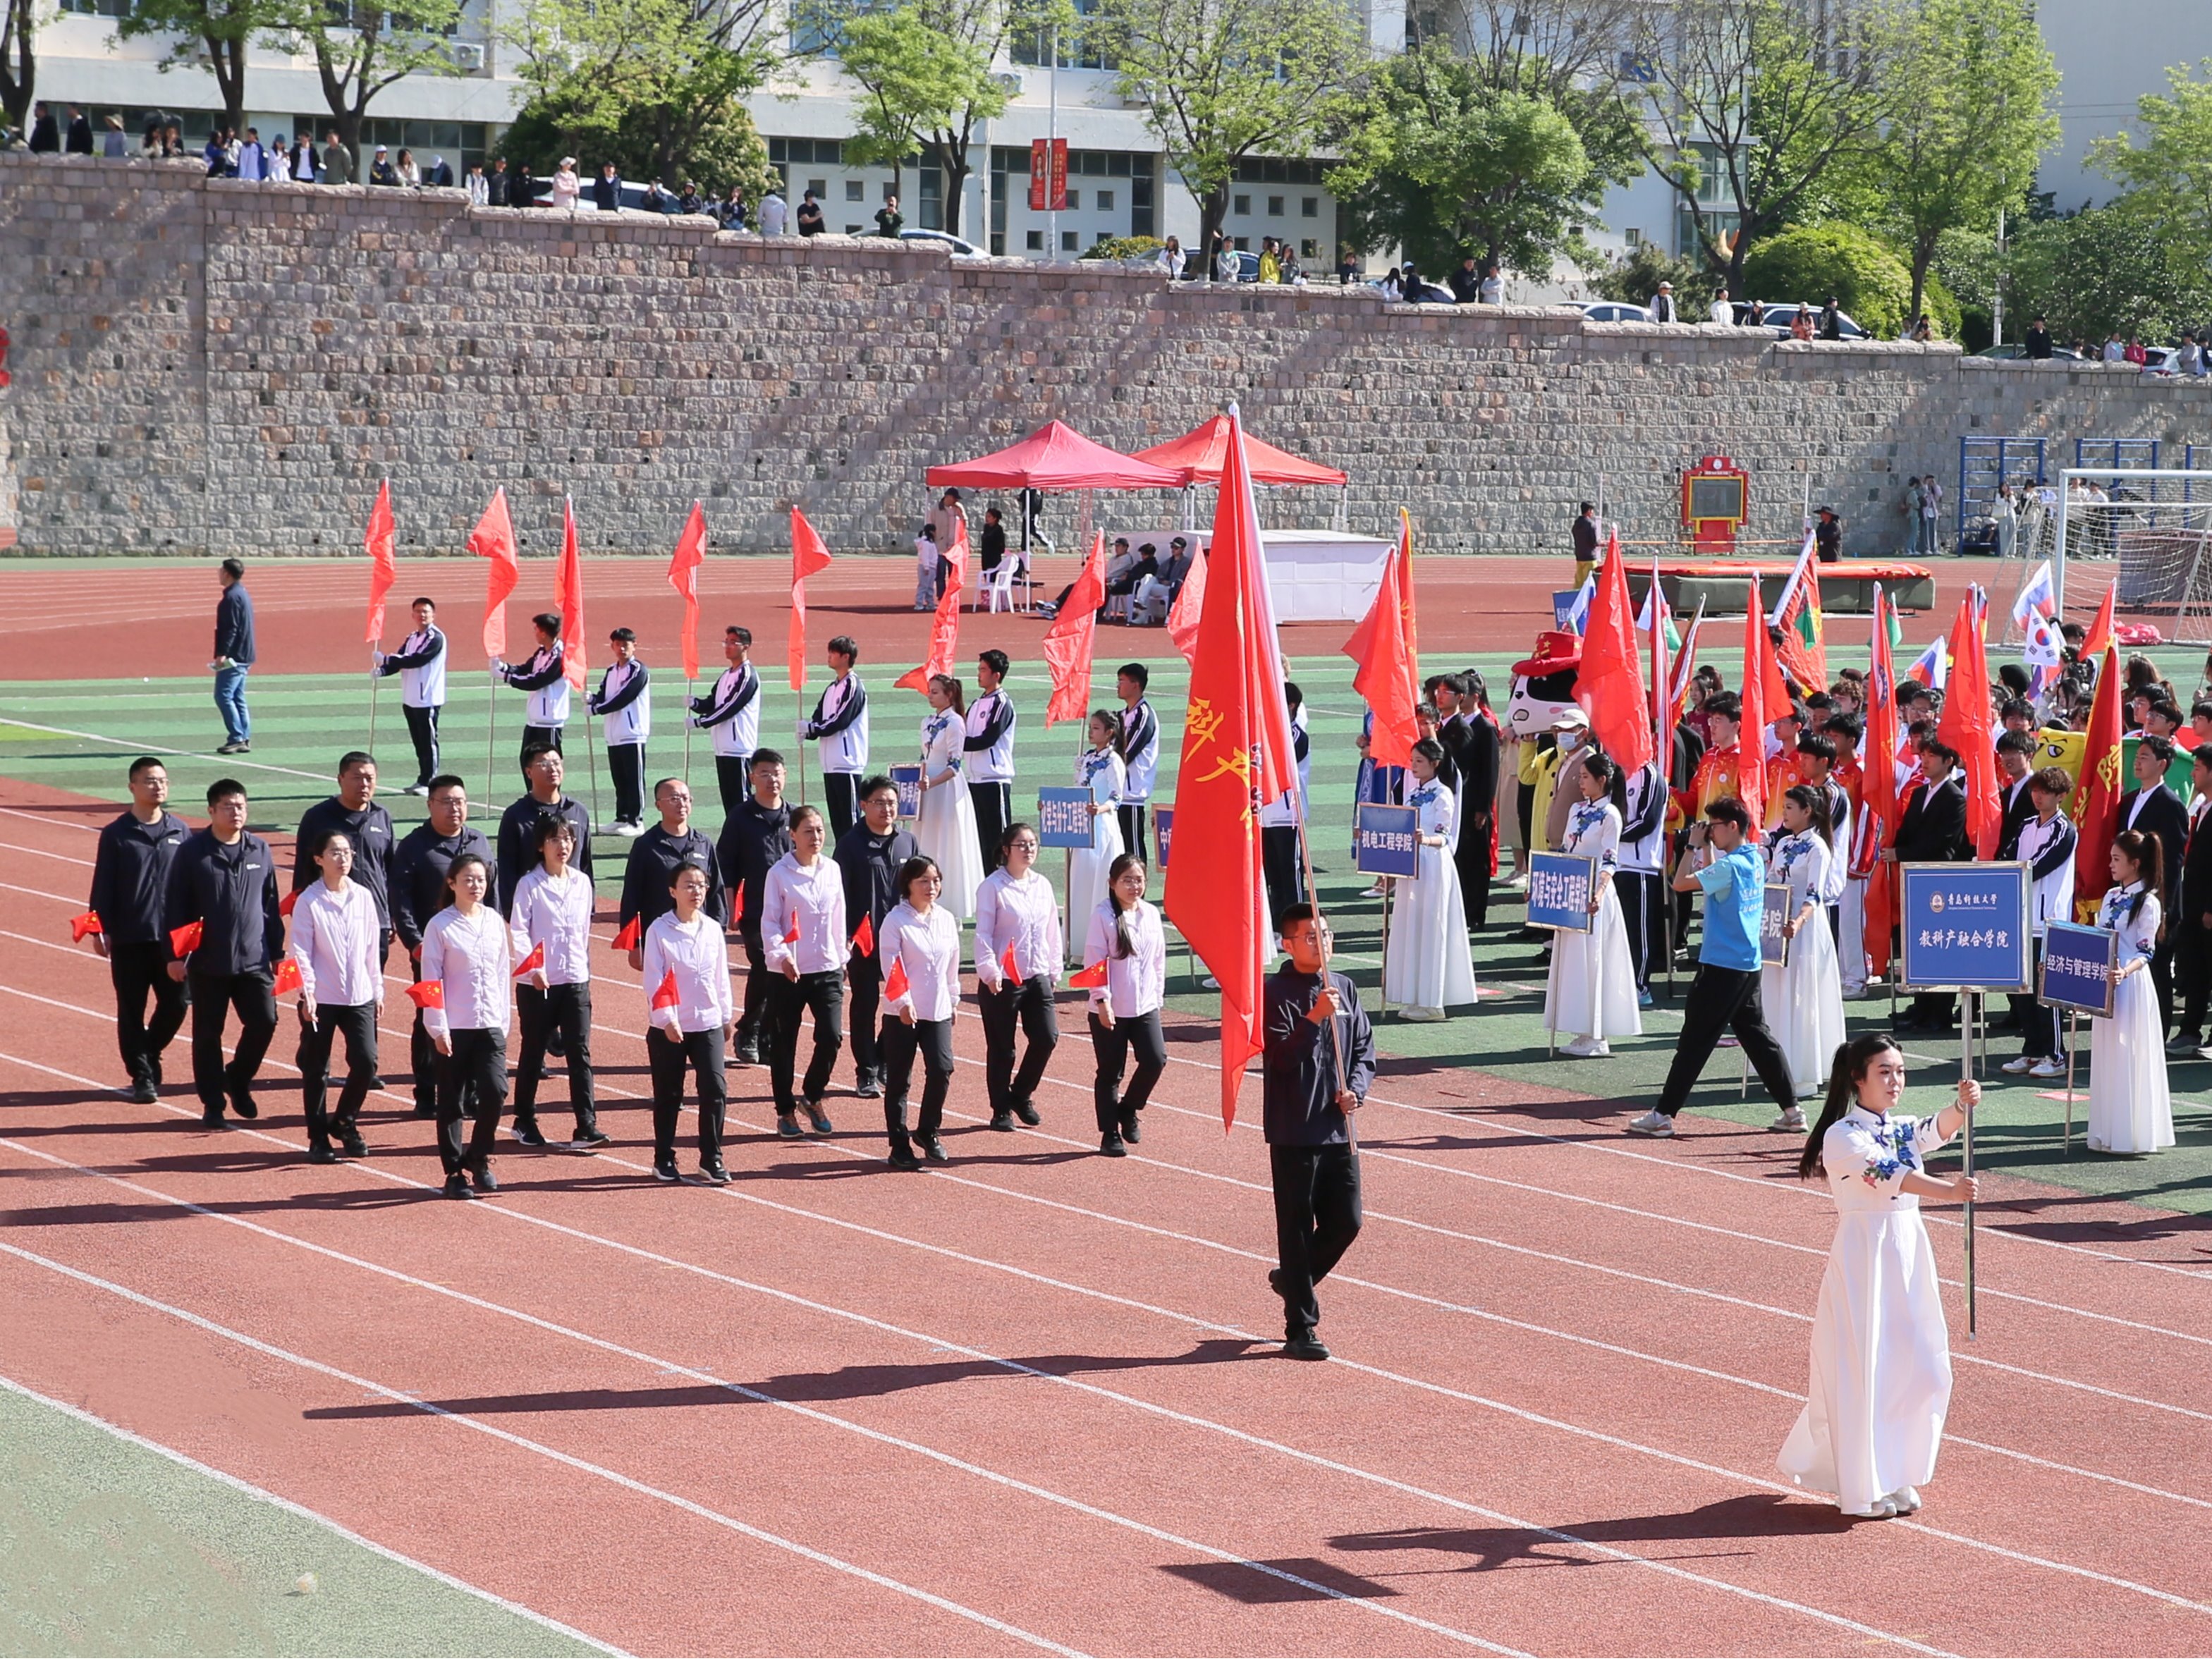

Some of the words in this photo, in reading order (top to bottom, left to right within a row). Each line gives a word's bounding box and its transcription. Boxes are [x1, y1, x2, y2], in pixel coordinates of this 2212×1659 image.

[893, 779, 919, 803] 际学院
[1362, 829, 1412, 852] 机电工程学院
[1531, 870, 1587, 913] 环境与安全工程学院
[1948, 893, 1997, 905] 青岛科技大学
[1919, 929, 2009, 949] 教科产融合学院
[2046, 953, 2109, 981] 经济与管理学院
